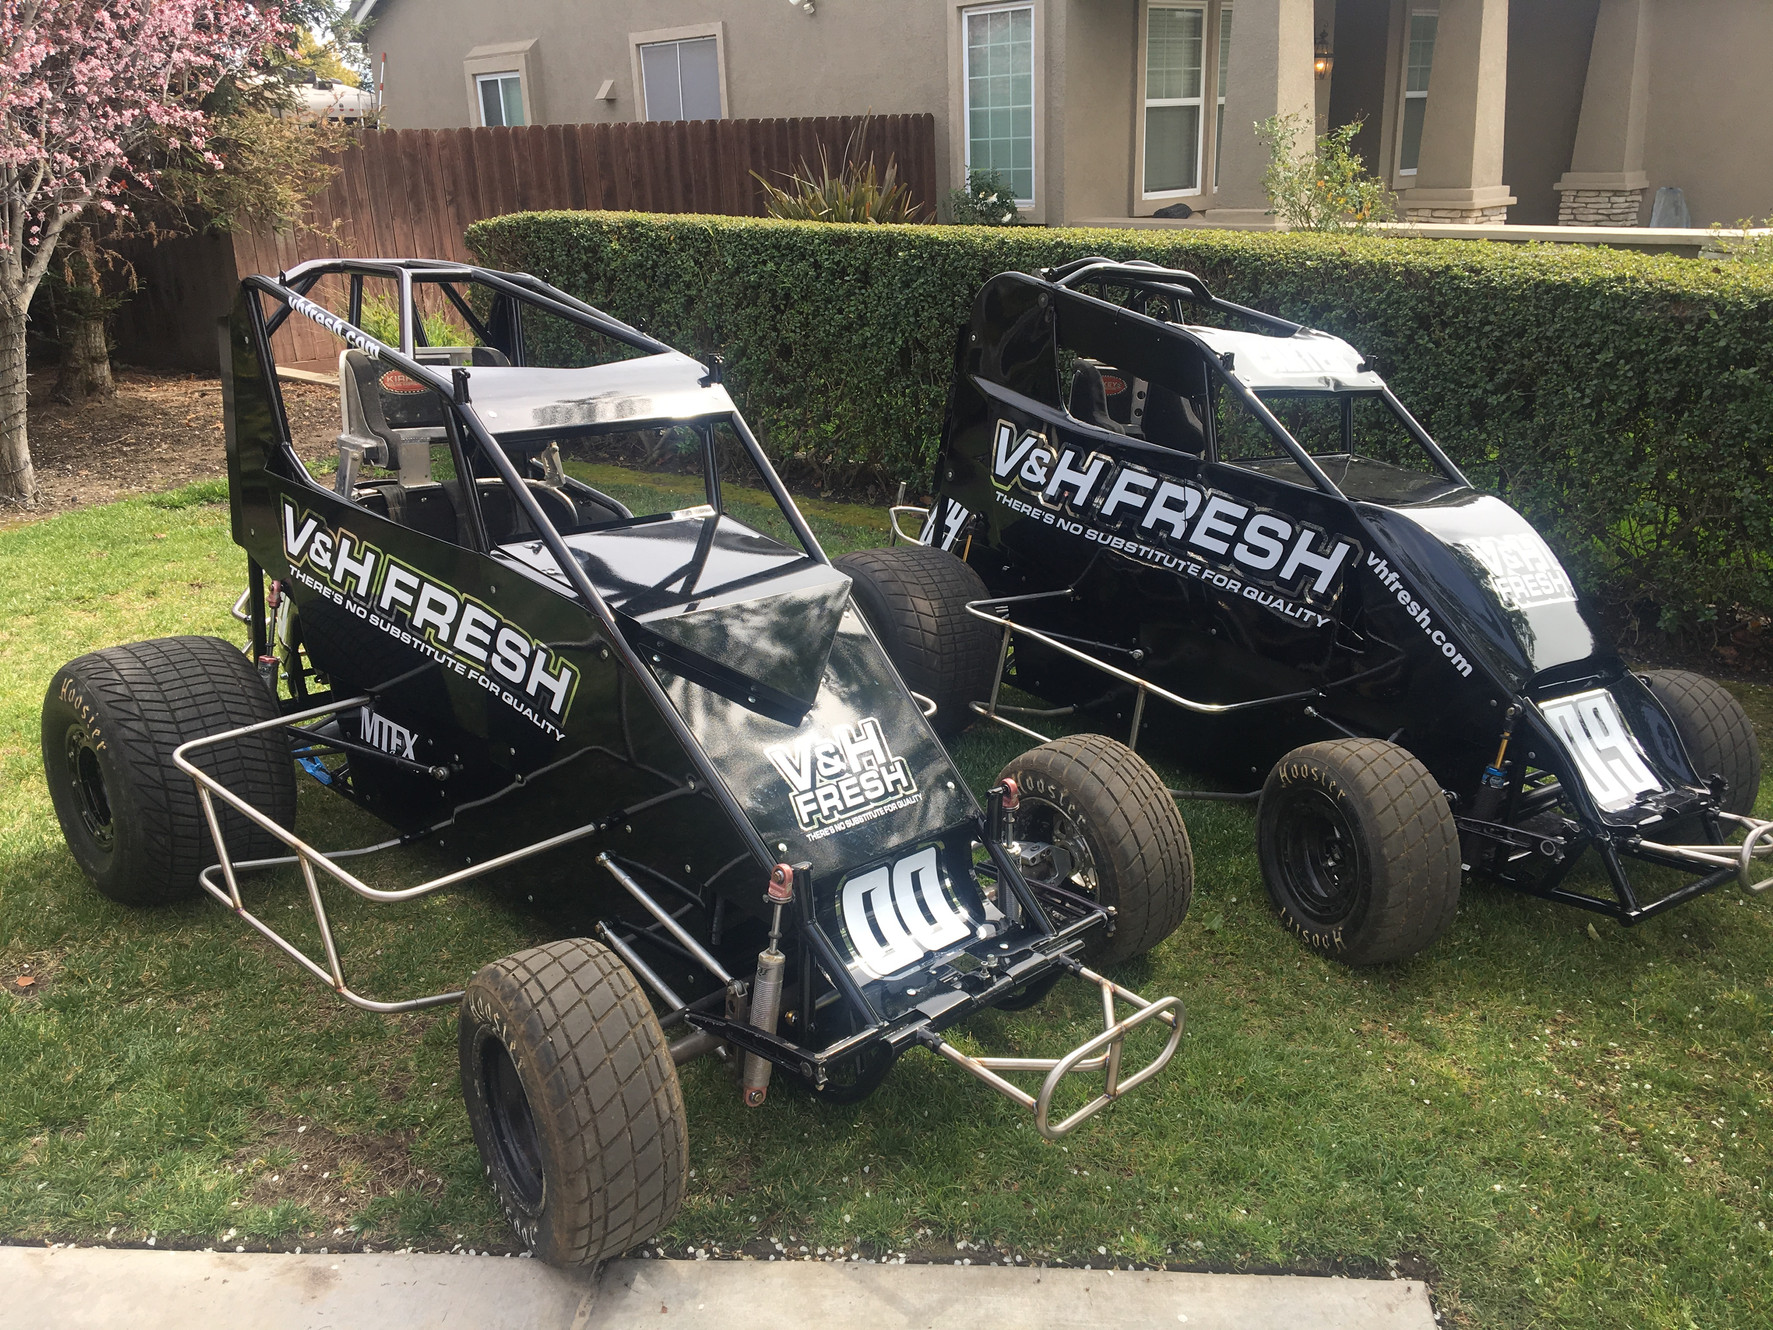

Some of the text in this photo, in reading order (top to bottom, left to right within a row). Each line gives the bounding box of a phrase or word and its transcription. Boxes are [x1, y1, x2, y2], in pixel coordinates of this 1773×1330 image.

[995, 426, 1351, 595] V&H FRESH
[995, 491, 1331, 628] THERE'S NO SUBSTITUTE FOR QUALITY
[284, 503, 573, 715] V&H FRESH
[1366, 550, 1473, 678] vhfresh.com
[1495, 571, 1569, 602] FRESH
[289, 564, 566, 742] THERE'S NO SUBSTITUTE FOR QUALITY
[360, 705, 419, 761] MTFX
[769, 721, 887, 792] V&H
[1279, 761, 1346, 800] Hoosier
[794, 759, 909, 824] FRESH
[806, 793, 923, 842] THERE'S NO SUBSTITUTE FOR QUALITY
[842, 846, 971, 975] 00
